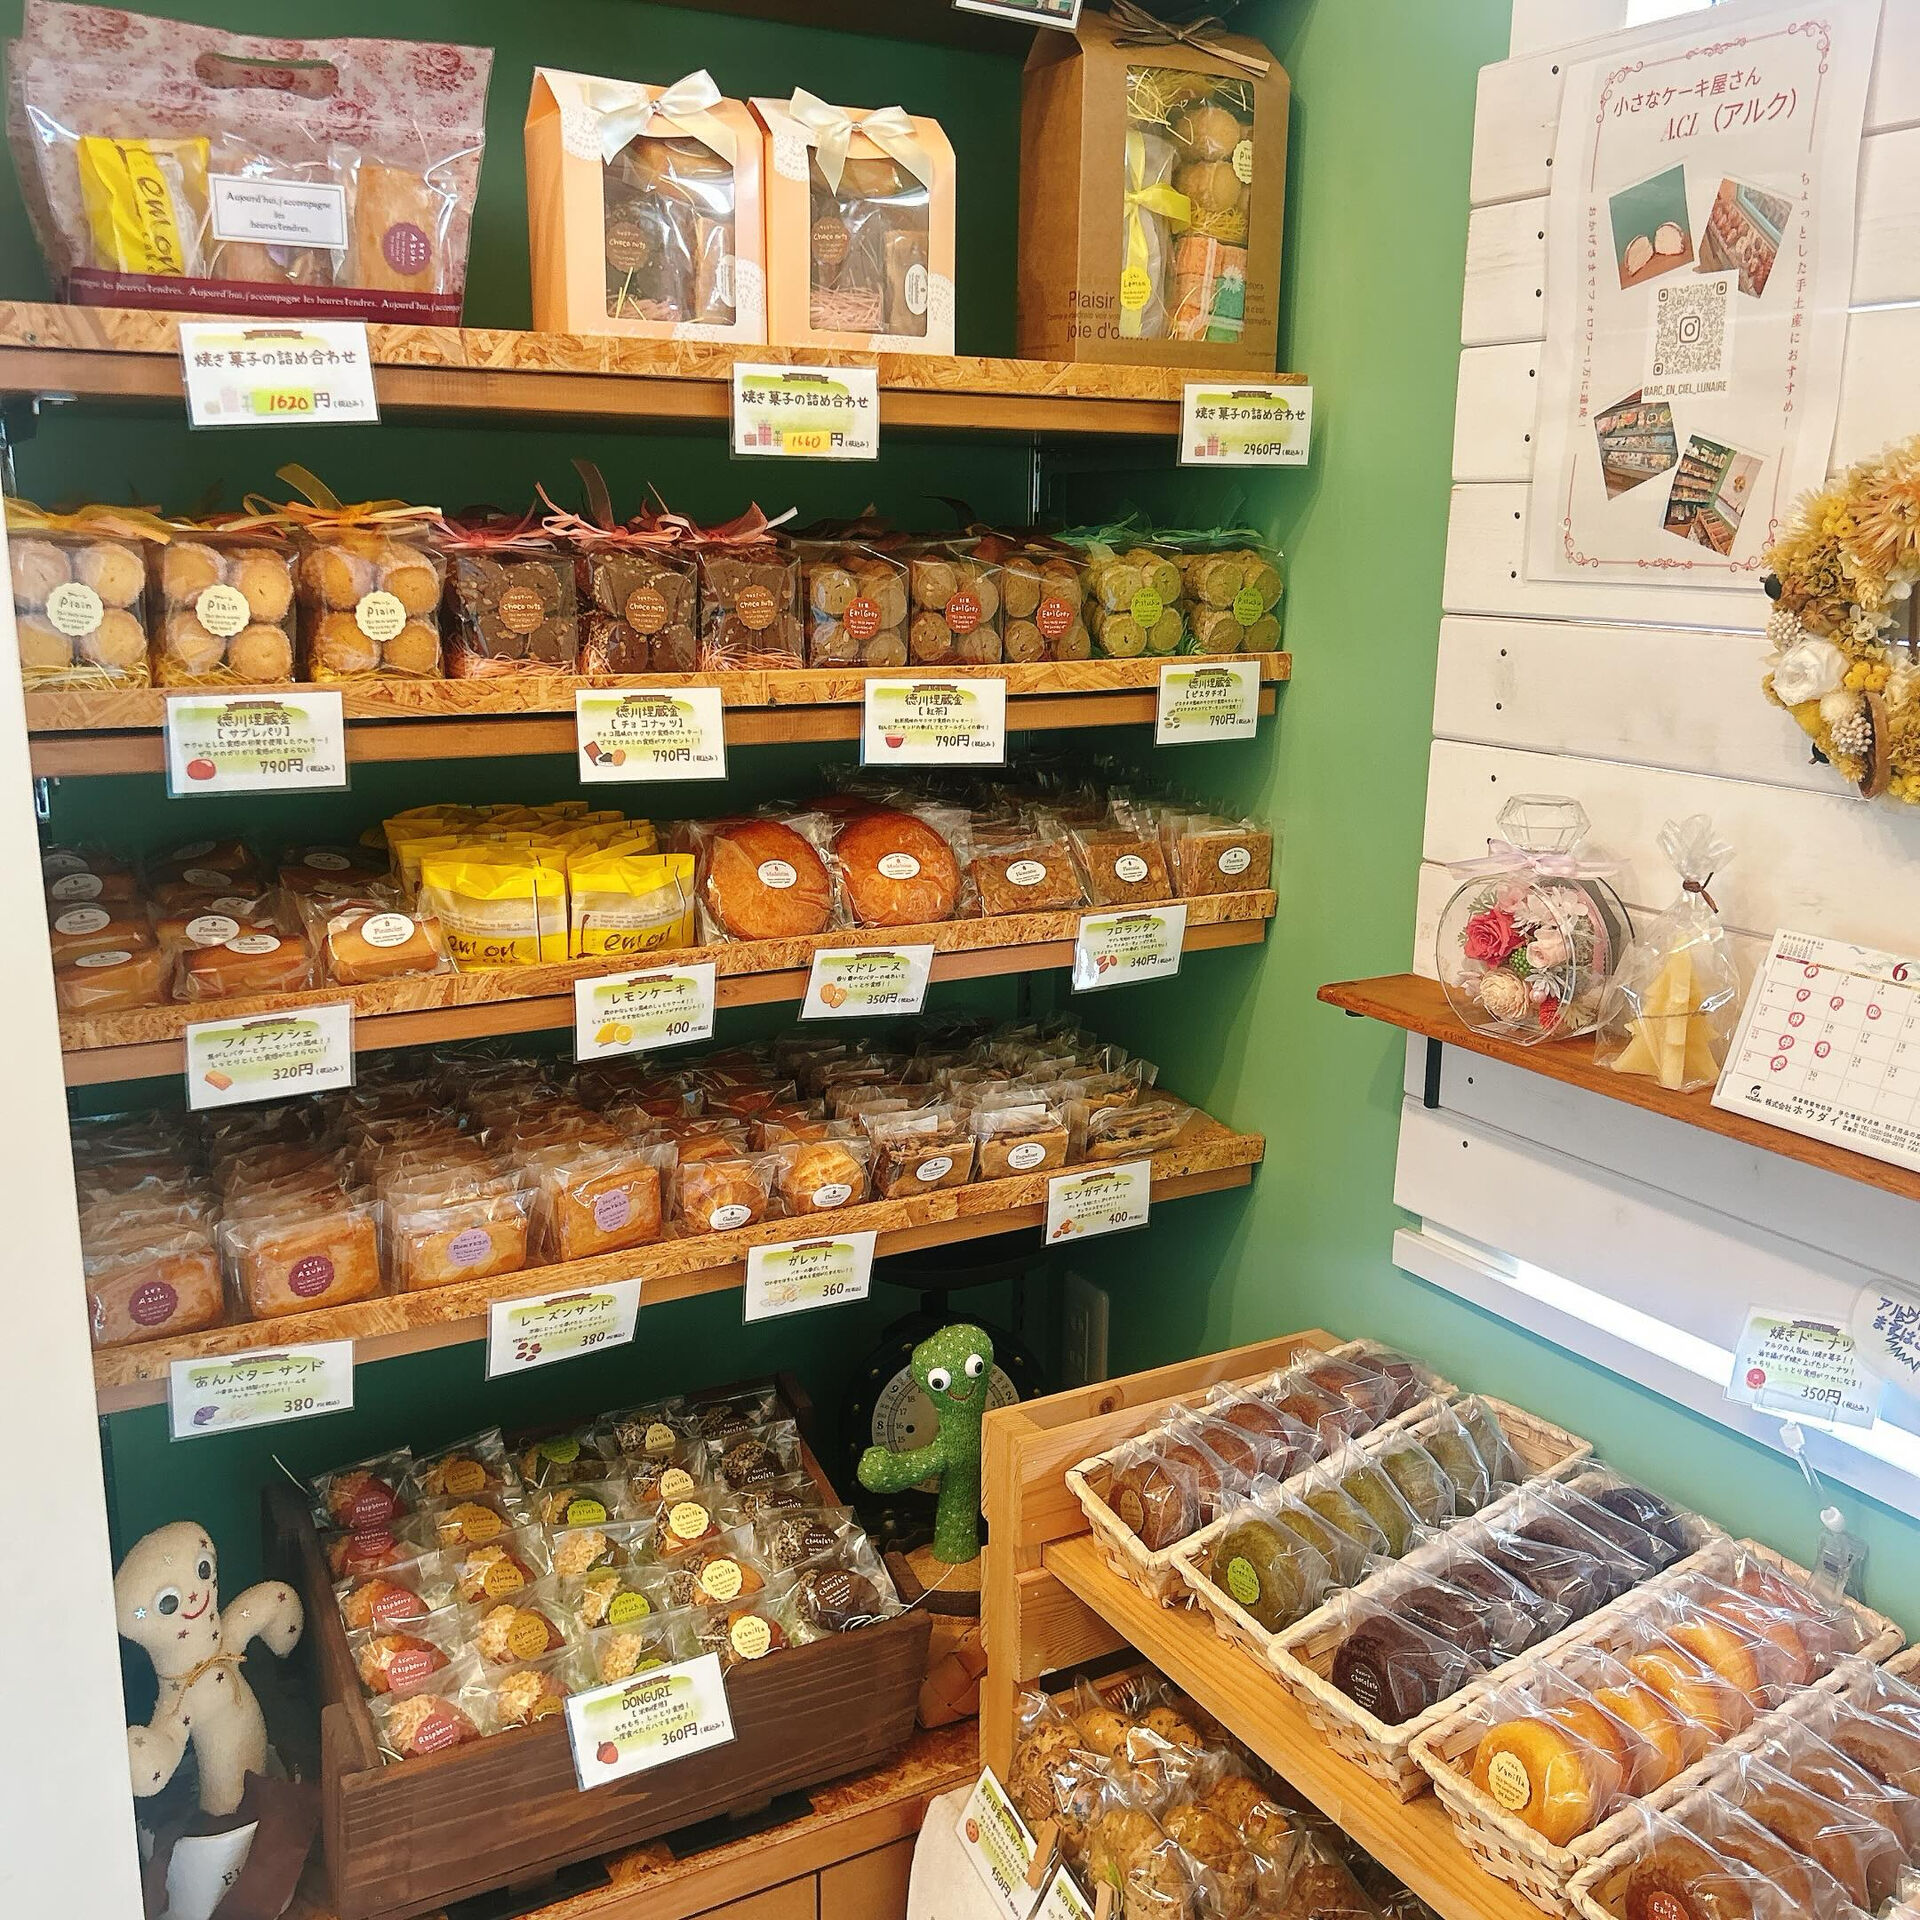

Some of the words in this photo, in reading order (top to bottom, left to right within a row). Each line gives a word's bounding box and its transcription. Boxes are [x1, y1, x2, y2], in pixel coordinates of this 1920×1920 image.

[1613, 67, 1762, 118] 小さなケーキ屋さん
[1068, 290, 1114, 309] Plaisir
[1067, 322, 1092, 347] joie
[194, 349, 357, 368] 焼き菓子の詰め合わせ
[742, 390, 869, 408] 焼き菓子の詰め合わせ
[1195, 406, 1306, 421] 焼き菓子の詰め合わせ
[1244, 442, 1281, 456] 2960円
[61, 596, 93, 611] Plain
[207, 600, 238, 612] Plain
[367, 606, 396, 617] Plain
[1188, 677, 1233, 689] 徳川埋蔵金
[905, 693, 964, 706] 徳川埋蔵金
[616, 704, 681, 719] 徳川埋蔵金
[918, 706, 948, 716] 【紅茶】
[217, 712, 292, 728] 徳川埋蔵金
[611, 718, 684, 730] 【チョコナッツ】
[1209, 713, 1236, 726] 790円
[935, 734, 970, 747] 790円
[653, 748, 690, 762] 790円
[260, 758, 303, 774] 790円
[1106, 922, 1160, 936] フロランタン
[845, 961, 901, 973] マドレーヌ
[1130, 954, 1158, 968] 340円
[1892, 962, 1912, 982] 6
[611, 984, 686, 1004] レモンケーキ
[866, 992, 897, 1004] 350円
[666, 1021, 690, 1037] 400
[1862, 1032, 1871, 1040] 17
[222, 1028, 313, 1049] フィナンシェ
[273, 1063, 314, 1081] 320円
[1793, 1104, 1841, 1127] ホウダイ
[1064, 1181, 1131, 1201] エンガディナー
[1108, 1211, 1128, 1225] 400
[788, 1250, 833, 1267] ガレット
[822, 1283, 844, 1297] 360
[521, 1298, 615, 1327] レーズンサンド
[580, 1331, 605, 1347] 380
[1769, 1325, 1855, 1353] 焼きドーナツ
[194, 1360, 326, 1389] あんバターサンド
[1801, 1385, 1842, 1406] 350円
[283, 1397, 314, 1414] 380
[876, 1421, 884, 1430] 8
[622, 1685, 673, 1710] DONGURI
[661, 1722, 698, 1746] 360円
[1496, 1763, 1525, 1788] Vanilla
